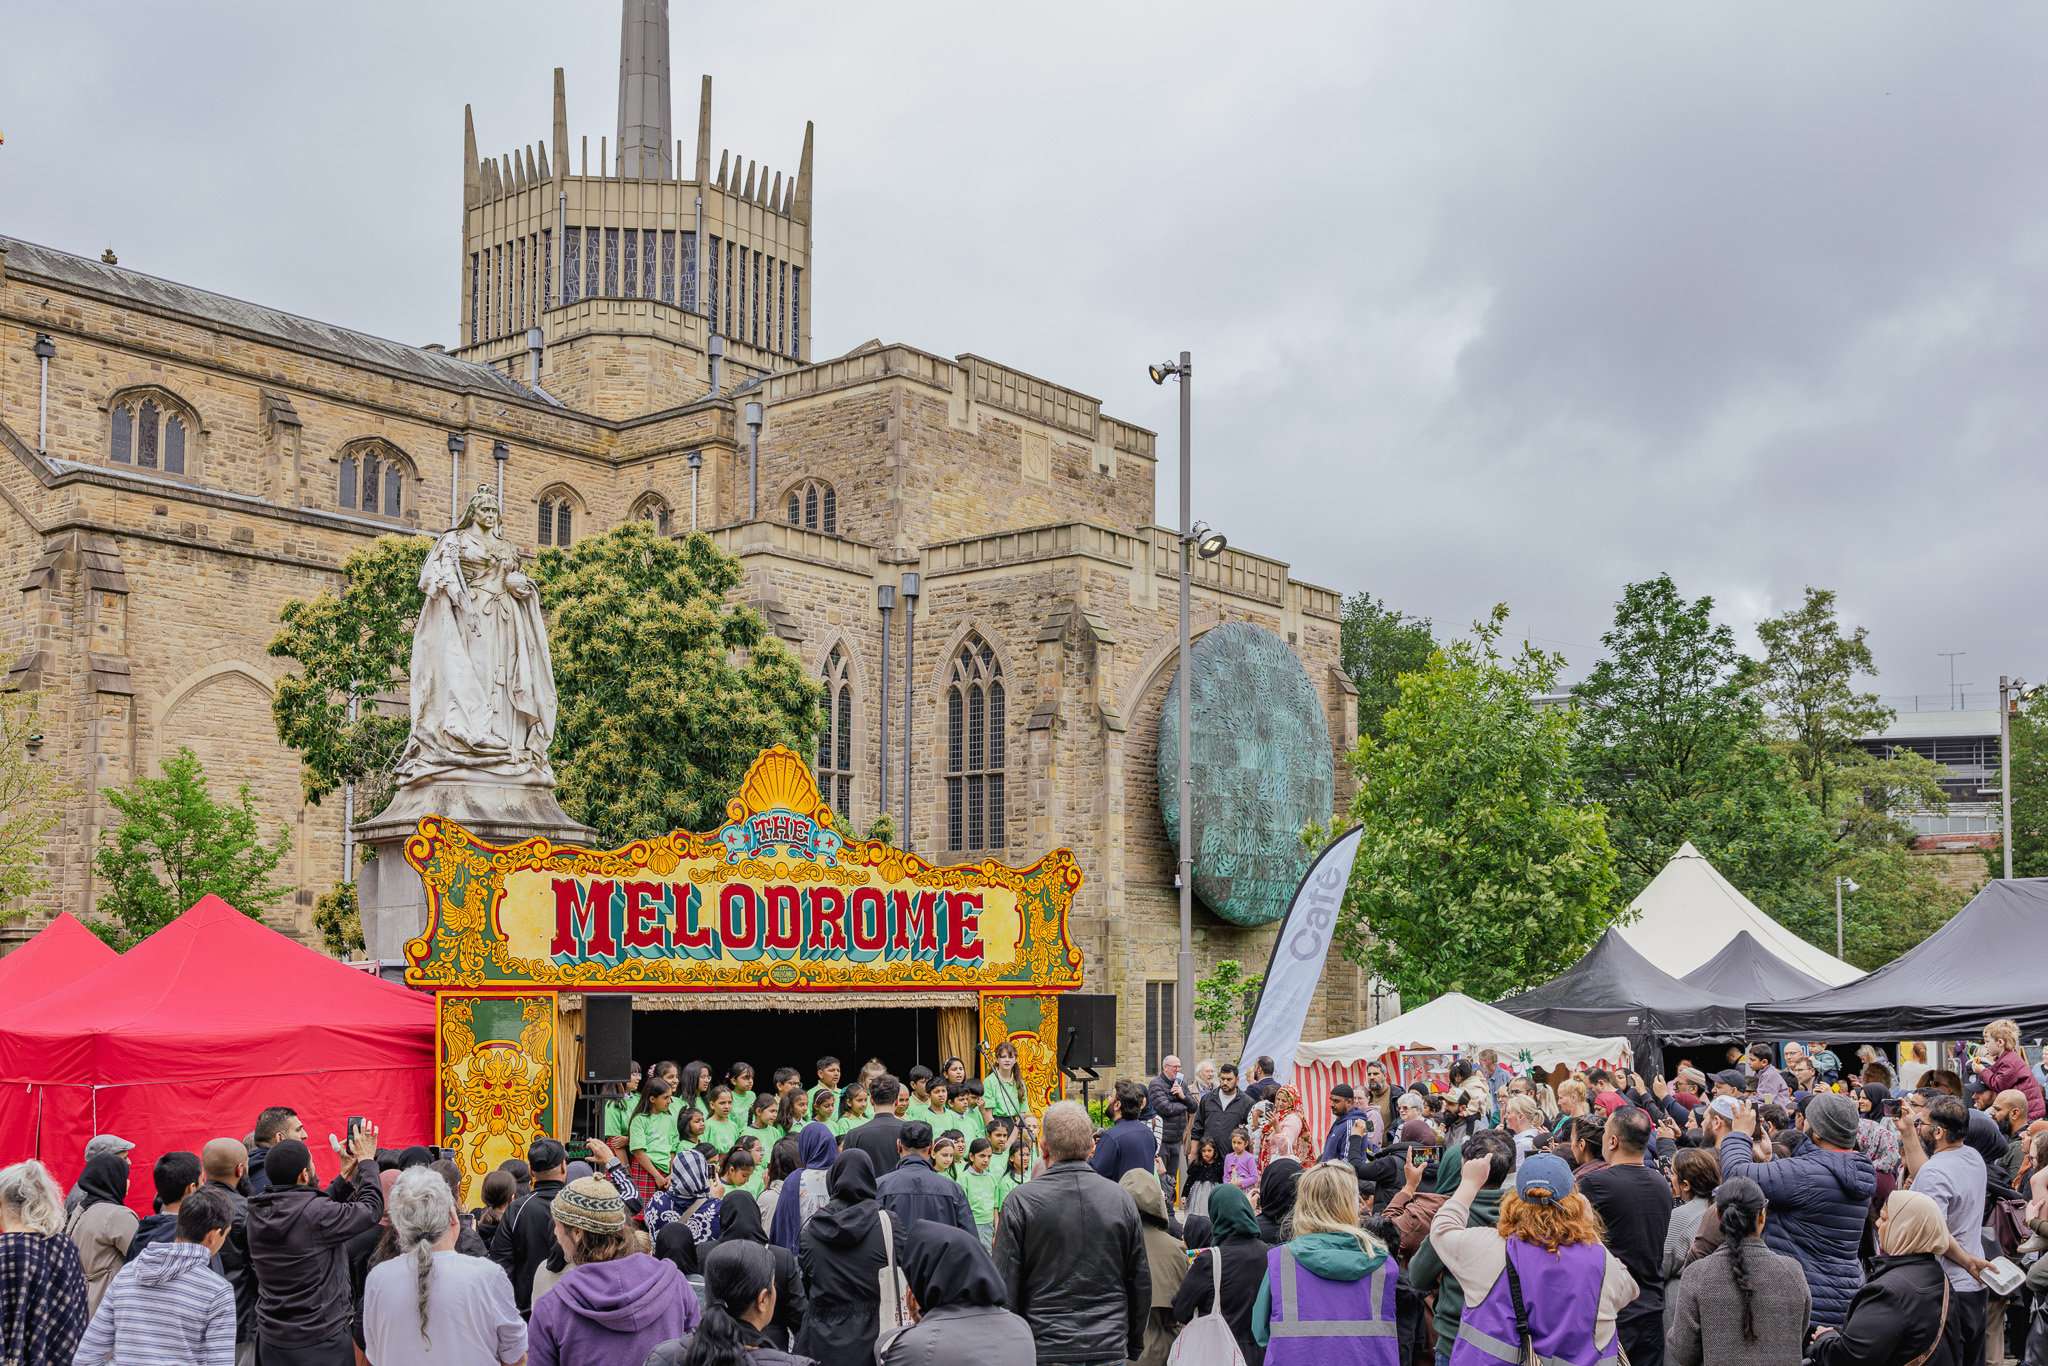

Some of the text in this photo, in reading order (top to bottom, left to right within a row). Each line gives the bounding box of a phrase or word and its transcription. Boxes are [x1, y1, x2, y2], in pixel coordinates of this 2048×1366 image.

[753, 815, 811, 846] THE
[550, 878, 986, 963] MELODROME
[1289, 866, 1342, 962] Café
